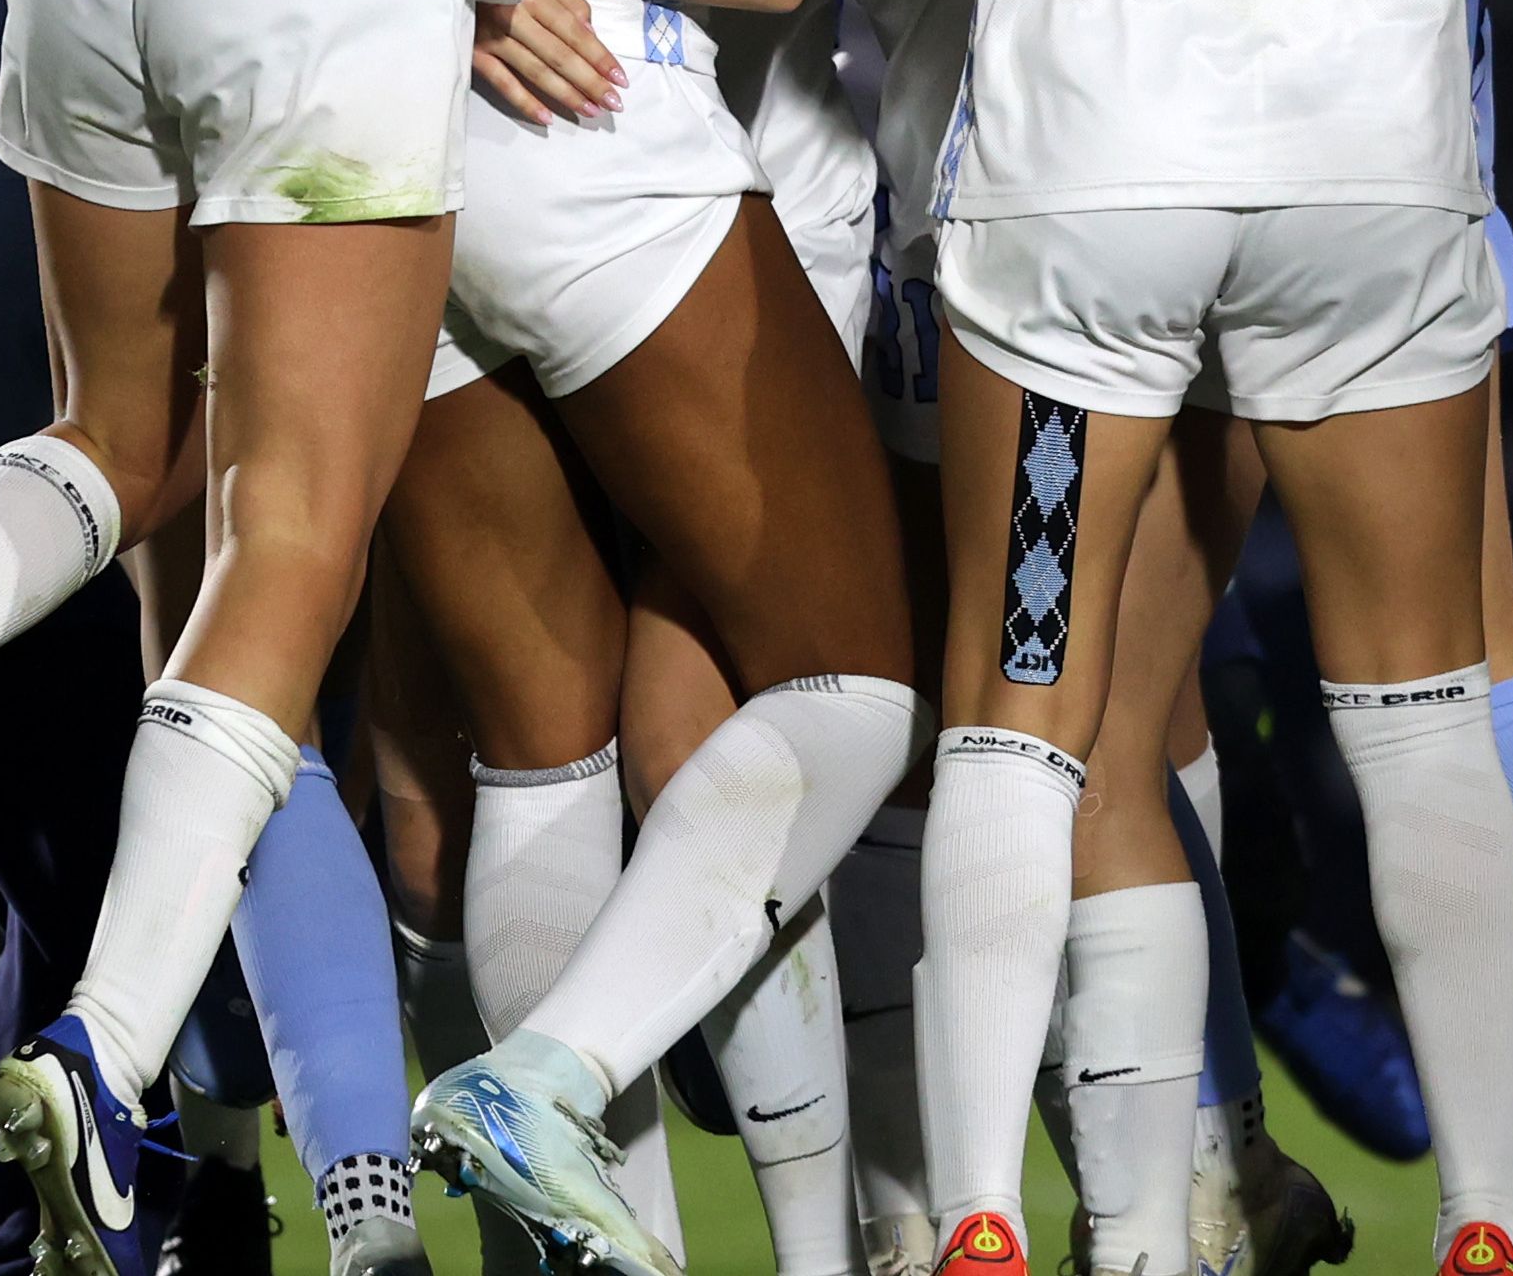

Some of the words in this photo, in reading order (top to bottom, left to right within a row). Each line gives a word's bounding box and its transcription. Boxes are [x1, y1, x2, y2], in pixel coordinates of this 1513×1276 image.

[1381, 686, 1465, 706] GRIP
[142, 705, 192, 726] GRIP
[960, 735, 1041, 753] NIKE
